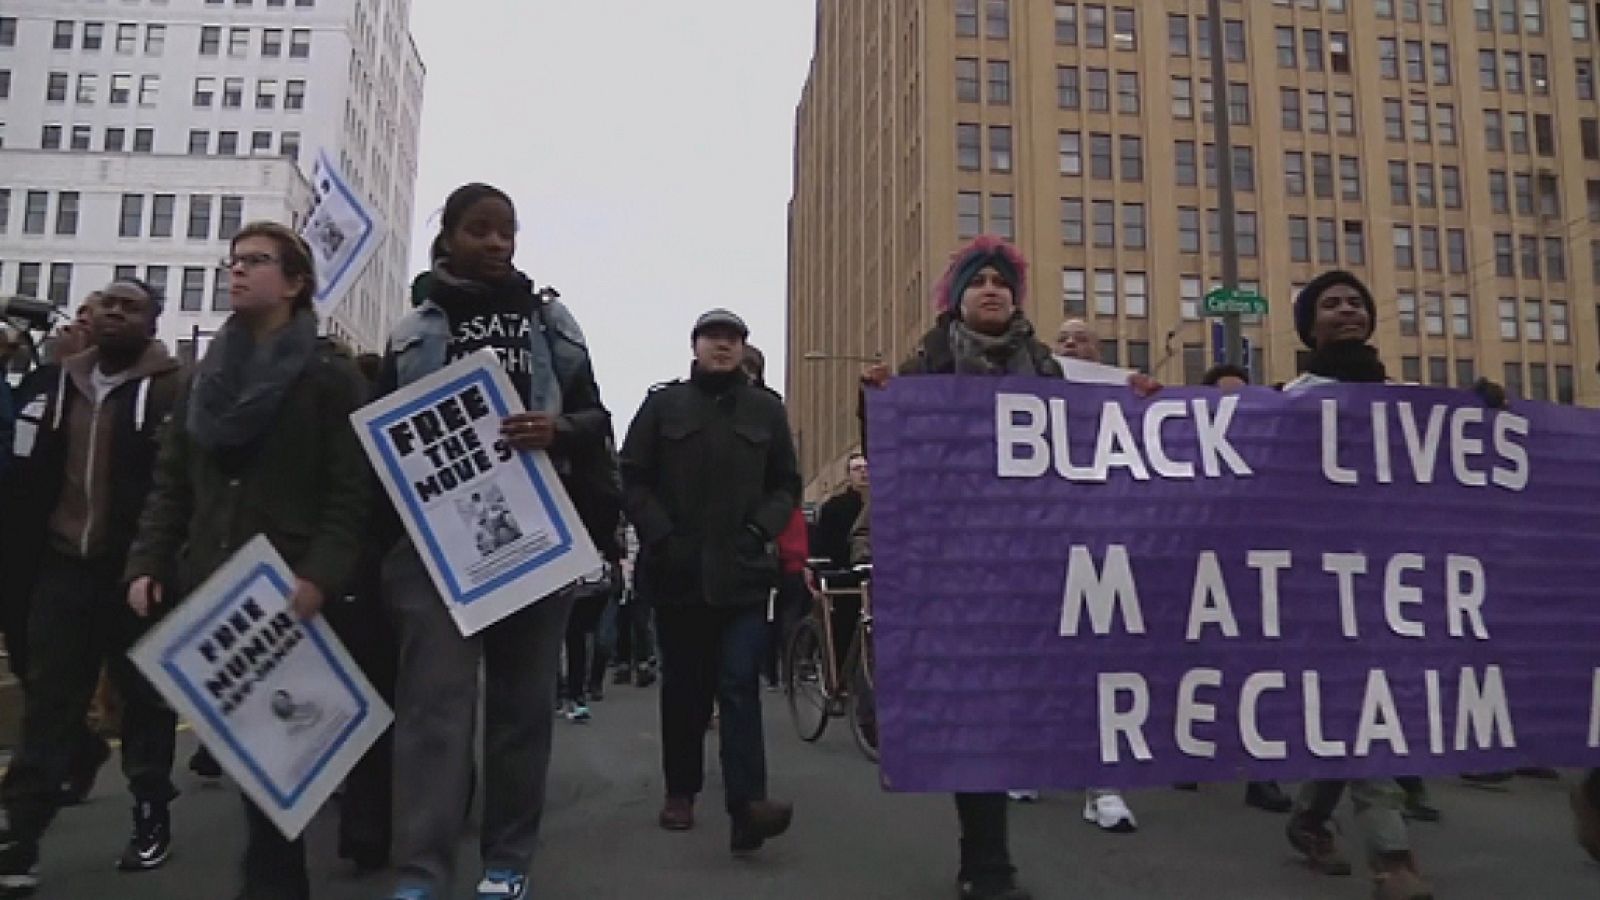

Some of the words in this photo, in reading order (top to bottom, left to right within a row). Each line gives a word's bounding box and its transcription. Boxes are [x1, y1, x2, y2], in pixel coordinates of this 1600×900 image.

[388, 385, 490, 457] FREE
[423, 427, 481, 468] THE
[996, 393, 1253, 480] BLACK
[1321, 399, 1529, 491] LIVES
[414, 449, 493, 502] MOVE
[1059, 544, 1490, 641] MATTER
[199, 597, 265, 663] FREE
[1098, 664, 1517, 763] RECLAIM
